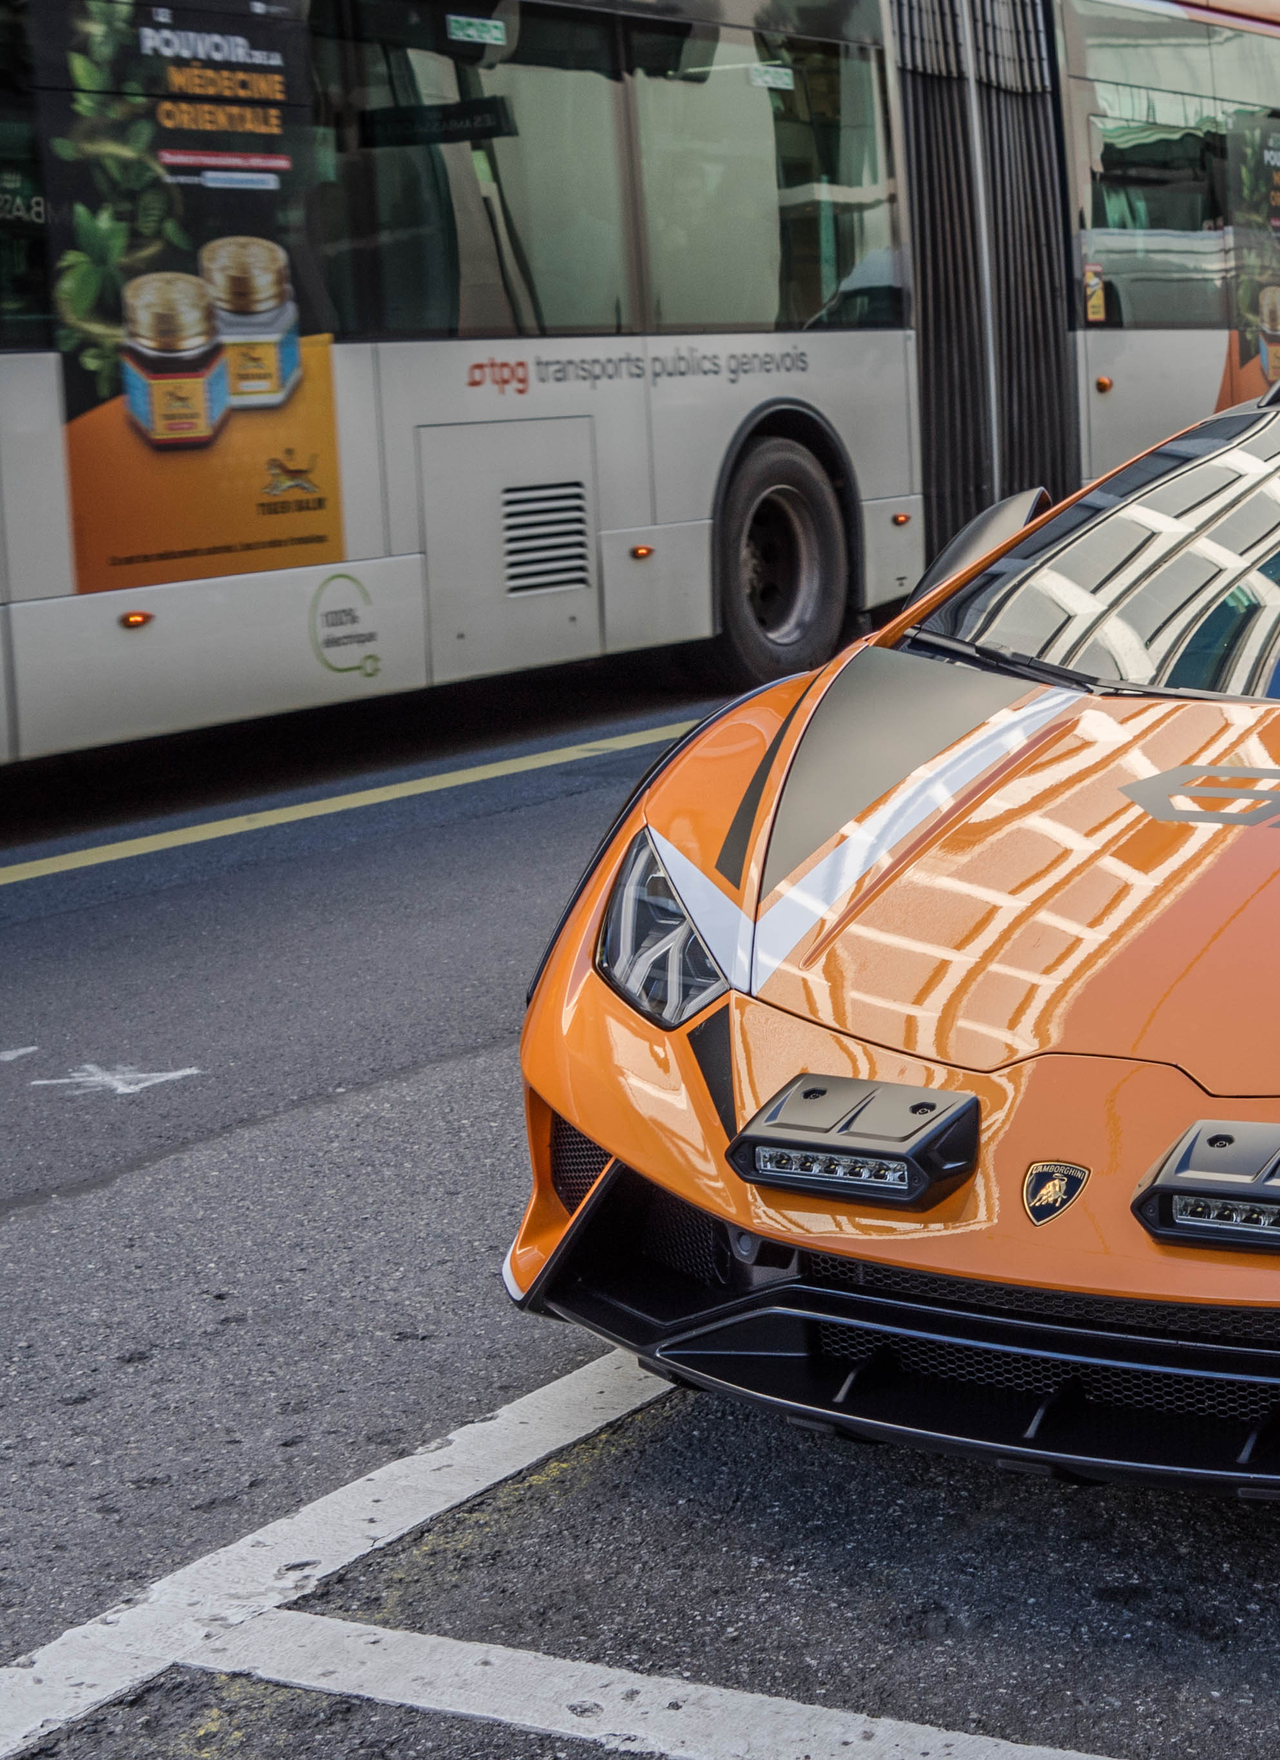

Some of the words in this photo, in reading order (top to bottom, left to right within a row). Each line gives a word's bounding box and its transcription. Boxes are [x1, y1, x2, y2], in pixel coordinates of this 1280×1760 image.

[140, 27, 250, 63] POUVOIR
[156, 101, 283, 134] ORIENTALE
[535, 352, 646, 390] transports
[650, 346, 722, 387] publics
[727, 345, 809, 384] genevois
[1032, 1164, 1085, 1180] LAMBORGHINI
